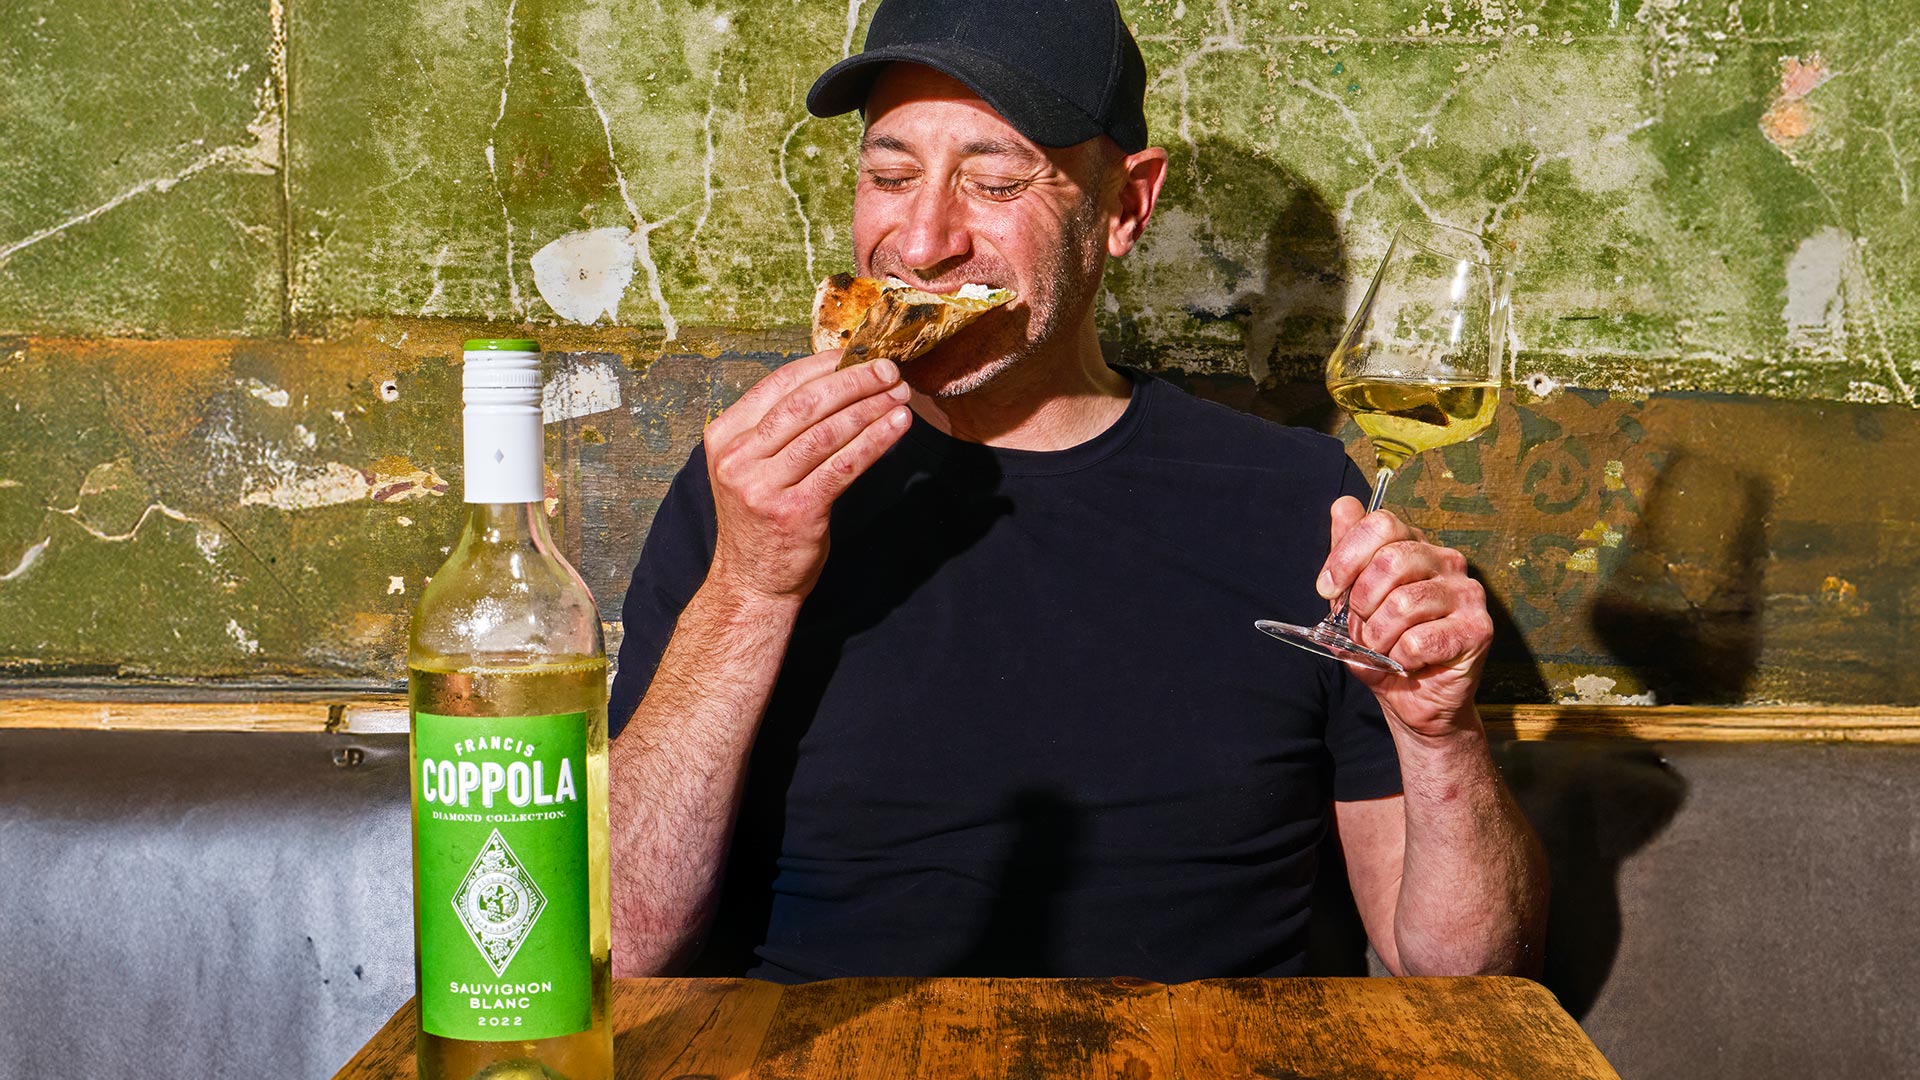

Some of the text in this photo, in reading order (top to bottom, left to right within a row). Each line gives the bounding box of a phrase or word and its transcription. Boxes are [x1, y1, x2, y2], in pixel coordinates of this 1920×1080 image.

[454, 737, 535, 757] FRANCIS
[422, 757, 577, 808] COPPOLA
[432, 812, 482, 823] DIAMOND
[450, 981, 551, 995] SAUVIGNON
[470, 998, 530, 1010] BLANC
[478, 1016, 522, 1027] 2022
